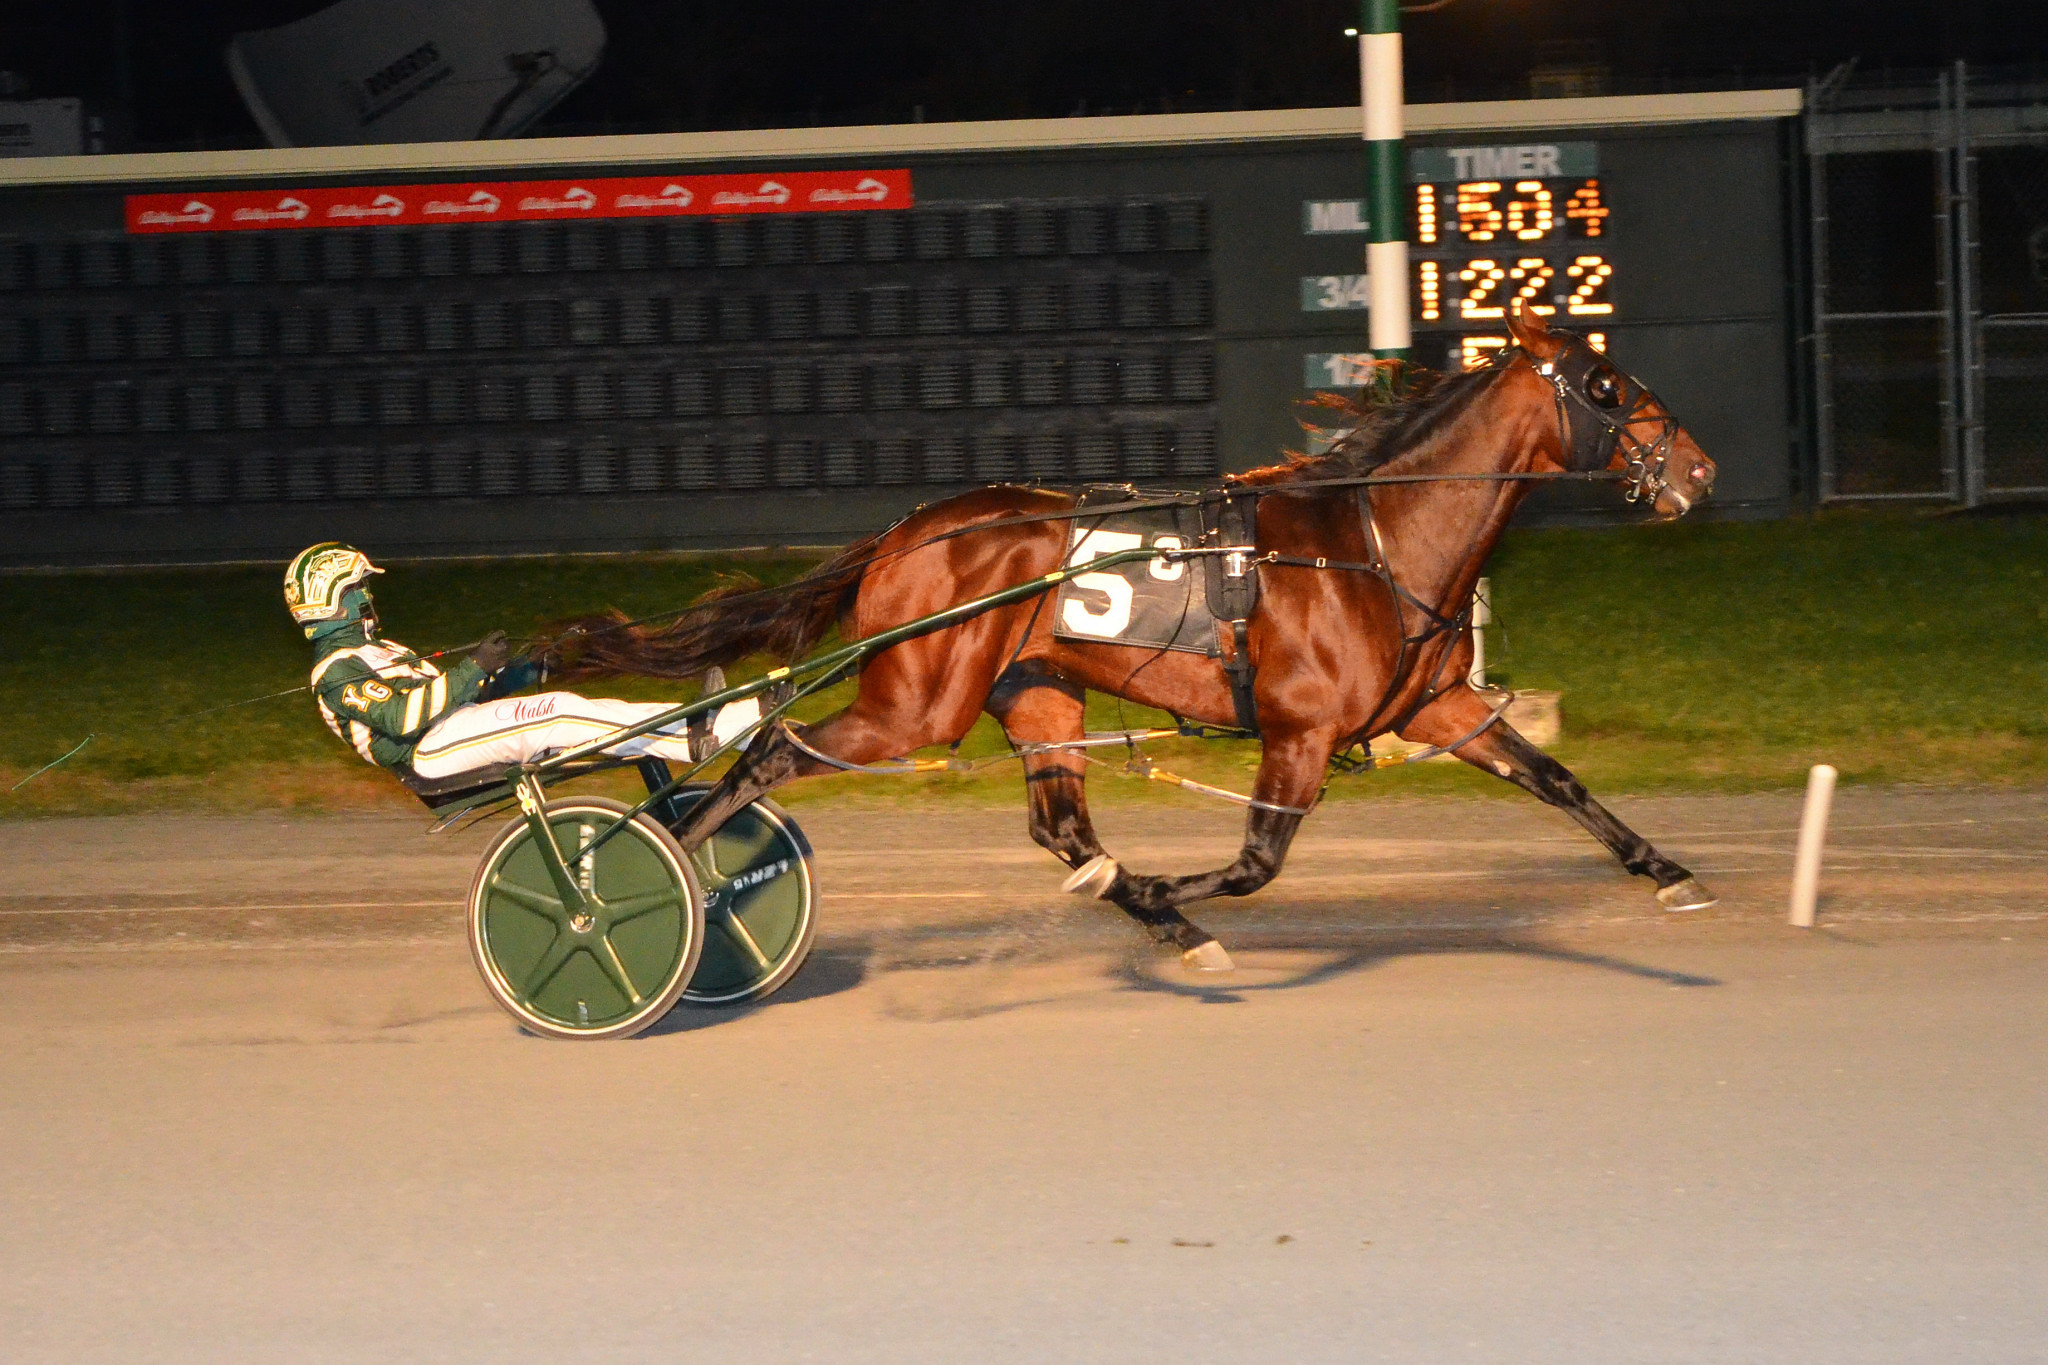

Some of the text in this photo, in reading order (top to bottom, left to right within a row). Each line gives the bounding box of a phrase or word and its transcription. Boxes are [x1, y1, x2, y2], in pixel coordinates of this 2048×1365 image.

[1447, 145, 1562, 178] TIMER
[1309, 202, 1371, 231] MIL
[1062, 528, 1142, 638] 5
[495, 696, 556, 722] Walsh
